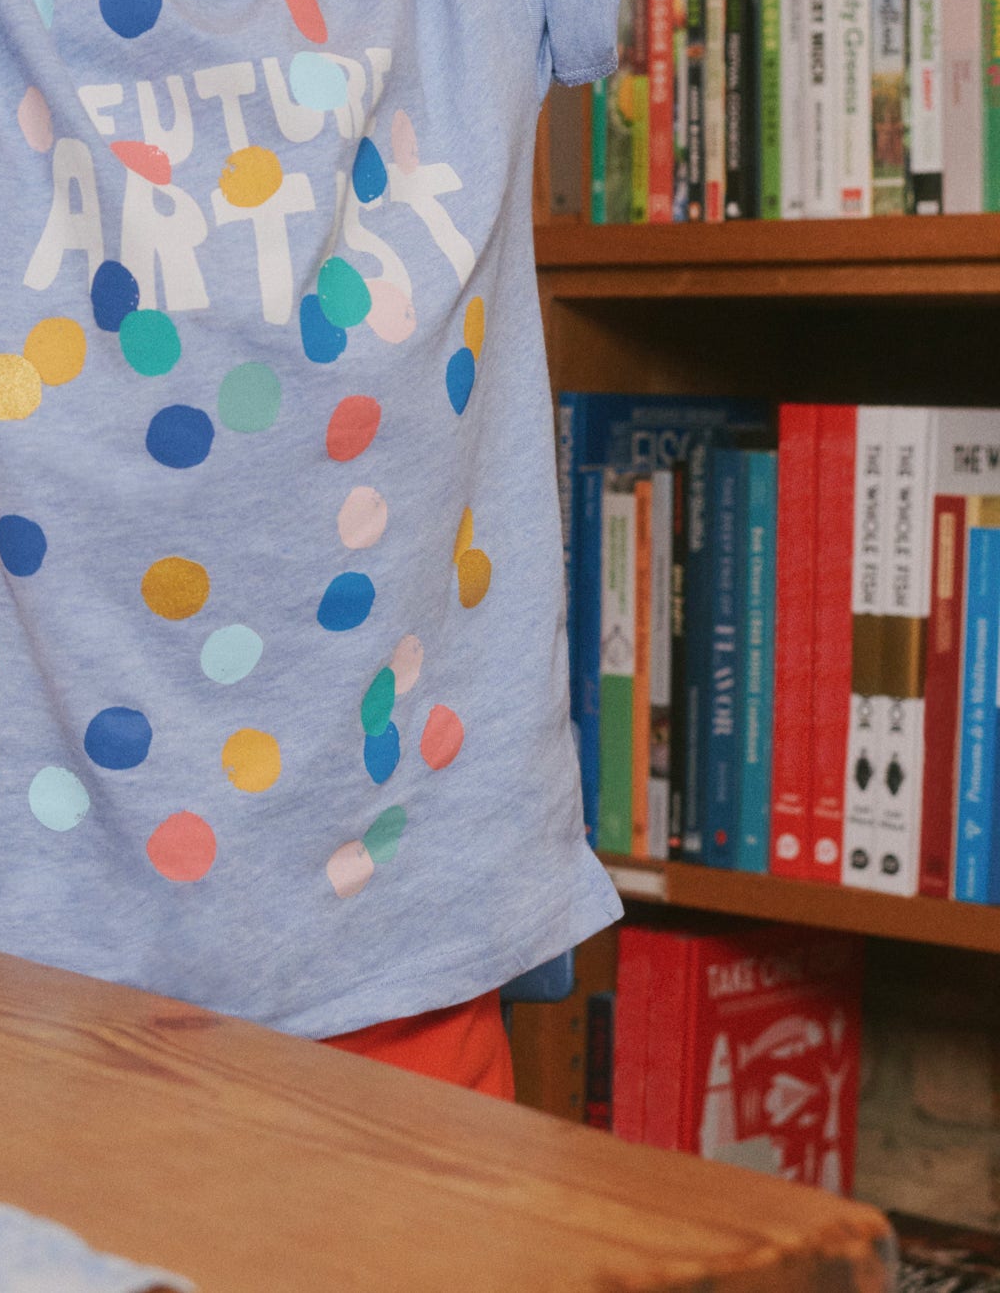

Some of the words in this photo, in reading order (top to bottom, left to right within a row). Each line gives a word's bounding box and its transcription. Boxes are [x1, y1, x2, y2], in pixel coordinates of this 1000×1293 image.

[810, 31, 826, 87] MUCH
[843, 27, 863, 115] Greens
[866, 444, 883, 477] THE
[897, 444, 915, 477] THE
[952, 444, 982, 474] THE
[863, 483, 881, 554] WHOLE
[894, 485, 912, 556] WHOLE
[861, 561, 880, 606] FISH
[893, 563, 911, 607] FISH
[711, 623, 736, 736] FLAVOR
